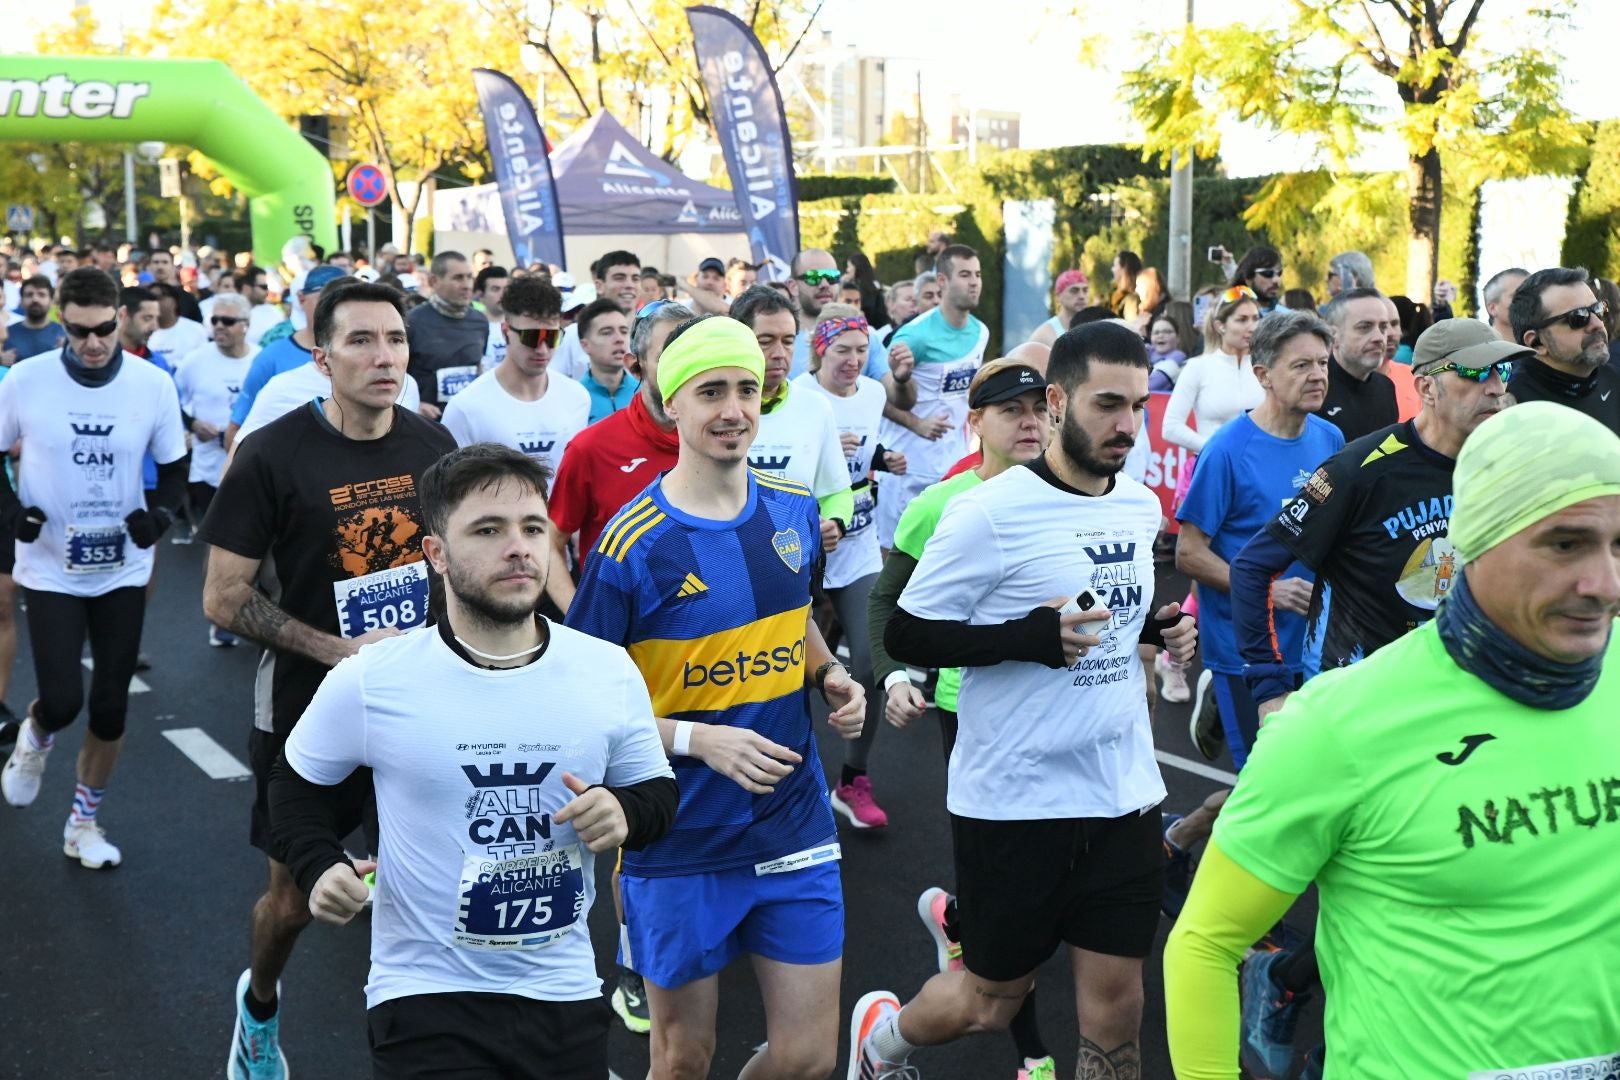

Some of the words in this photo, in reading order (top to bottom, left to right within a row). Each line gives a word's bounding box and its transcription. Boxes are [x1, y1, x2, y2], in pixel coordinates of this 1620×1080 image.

[602, 182, 691, 197] Alicante
[73, 452, 114, 466] CAN
[1411, 519, 1448, 540] PENYA
[80, 546, 117, 562] 353
[348, 573, 420, 598] CASTILLOS
[1096, 563, 1137, 589] ALI
[360, 584, 413, 606] ALICANTE
[363, 600, 416, 632] 508
[1067, 662, 1082, 672] LA
[1073, 675, 1095, 686] LOS
[518, 742, 560, 752] Sprinter
[476, 788, 540, 817] ALI
[468, 813, 552, 845] CAN
[477, 860, 572, 885] CASTILLOS
[479, 852, 559, 874] CARRERA
[490, 875, 562, 896] ALICANTE
[494, 895, 553, 929] 175
